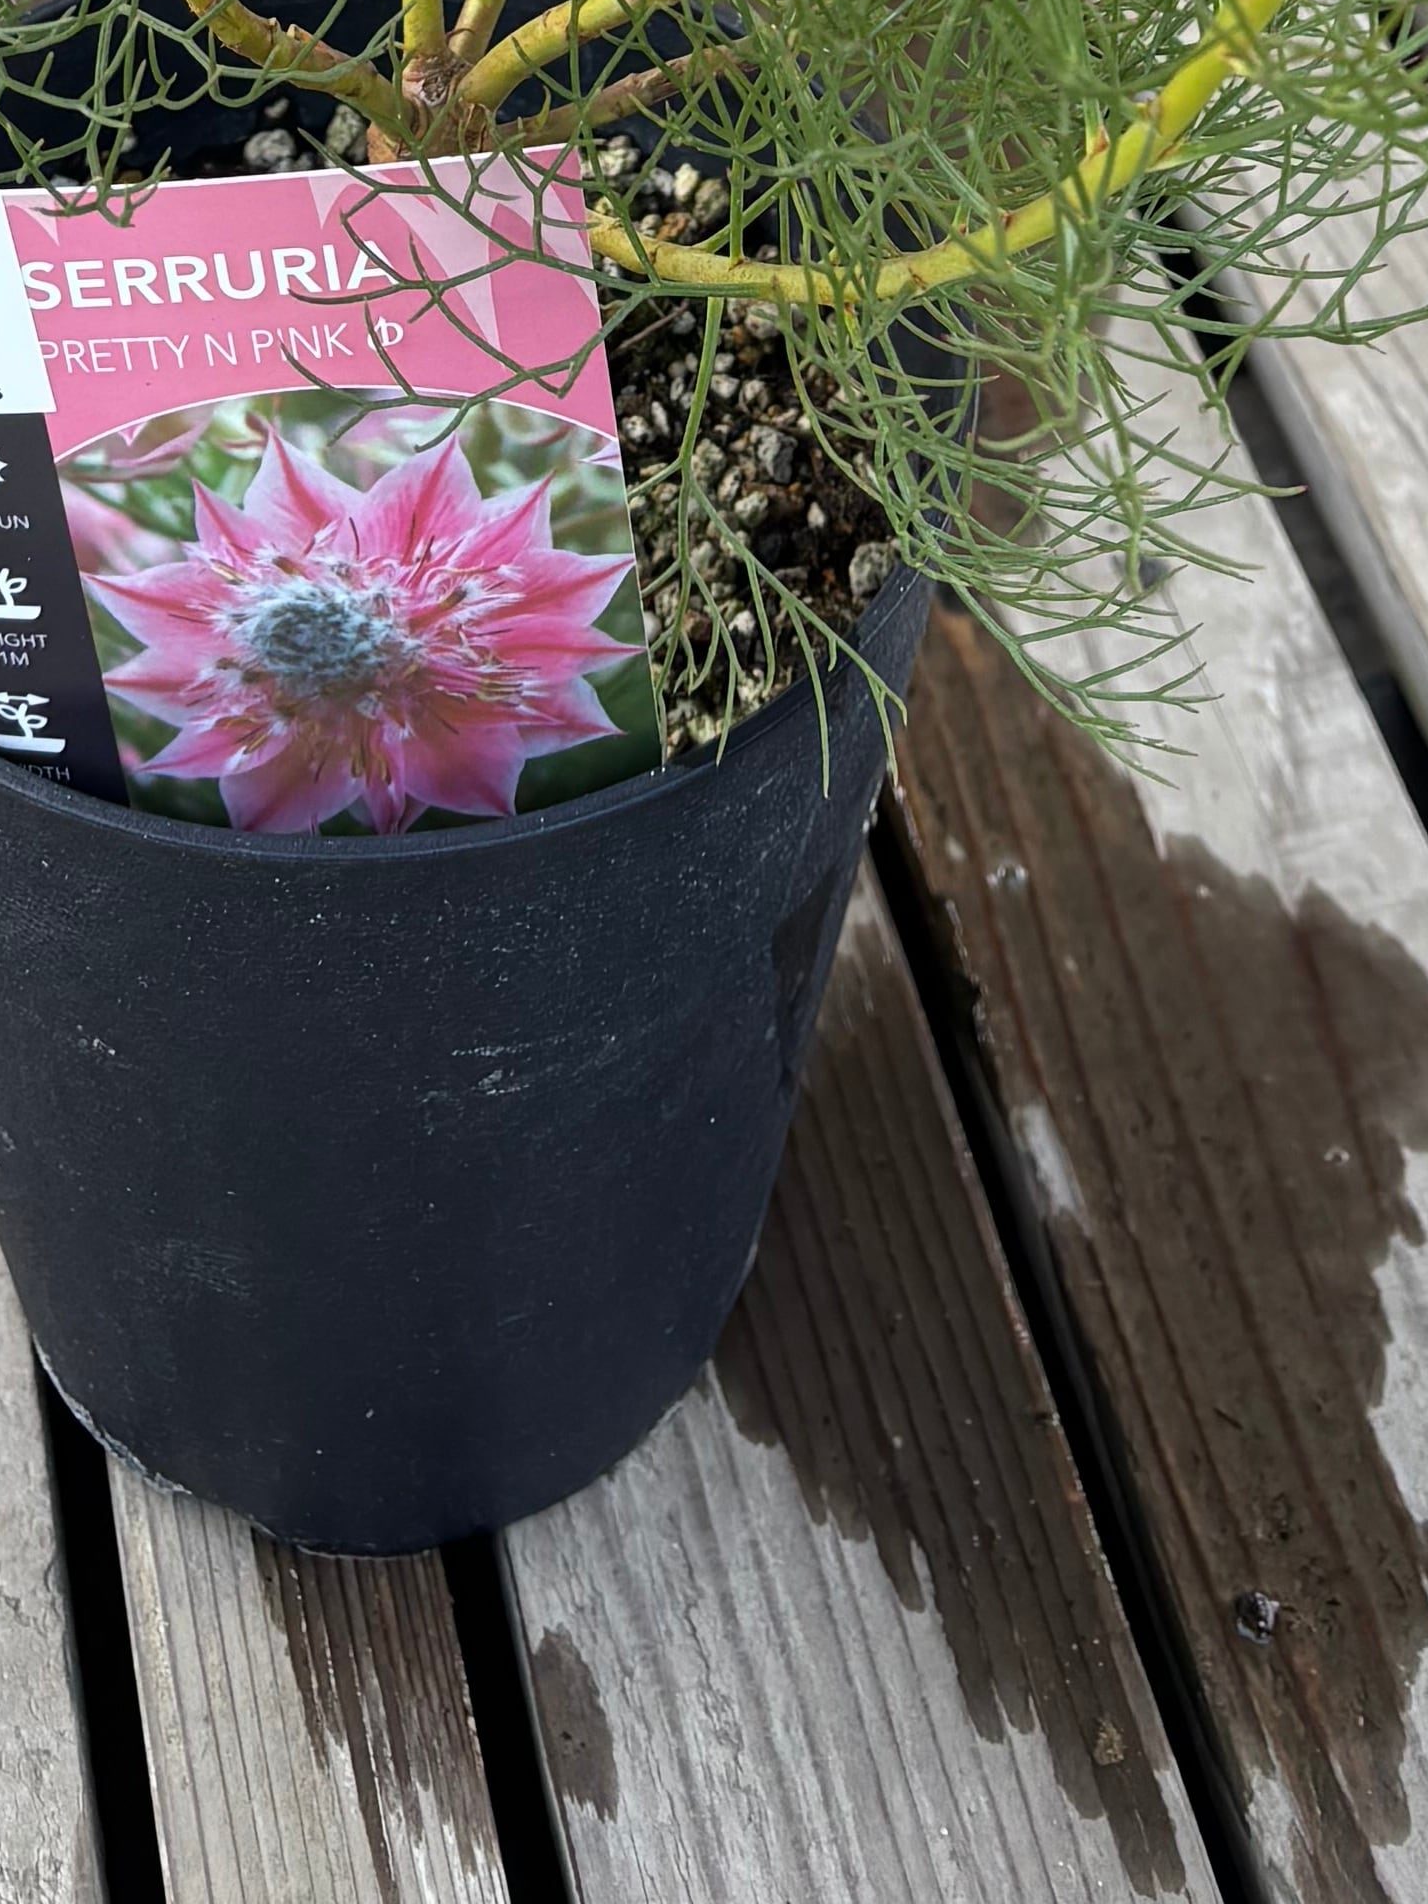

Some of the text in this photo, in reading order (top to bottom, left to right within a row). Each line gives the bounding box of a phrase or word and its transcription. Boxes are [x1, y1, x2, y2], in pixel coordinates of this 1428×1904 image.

[21, 240, 401, 310] SERRURIA
[38, 322, 354, 374] PRETTY N PINK
[0, 650, 30, 666] 1M
[19, 762, 70, 781] DTH
